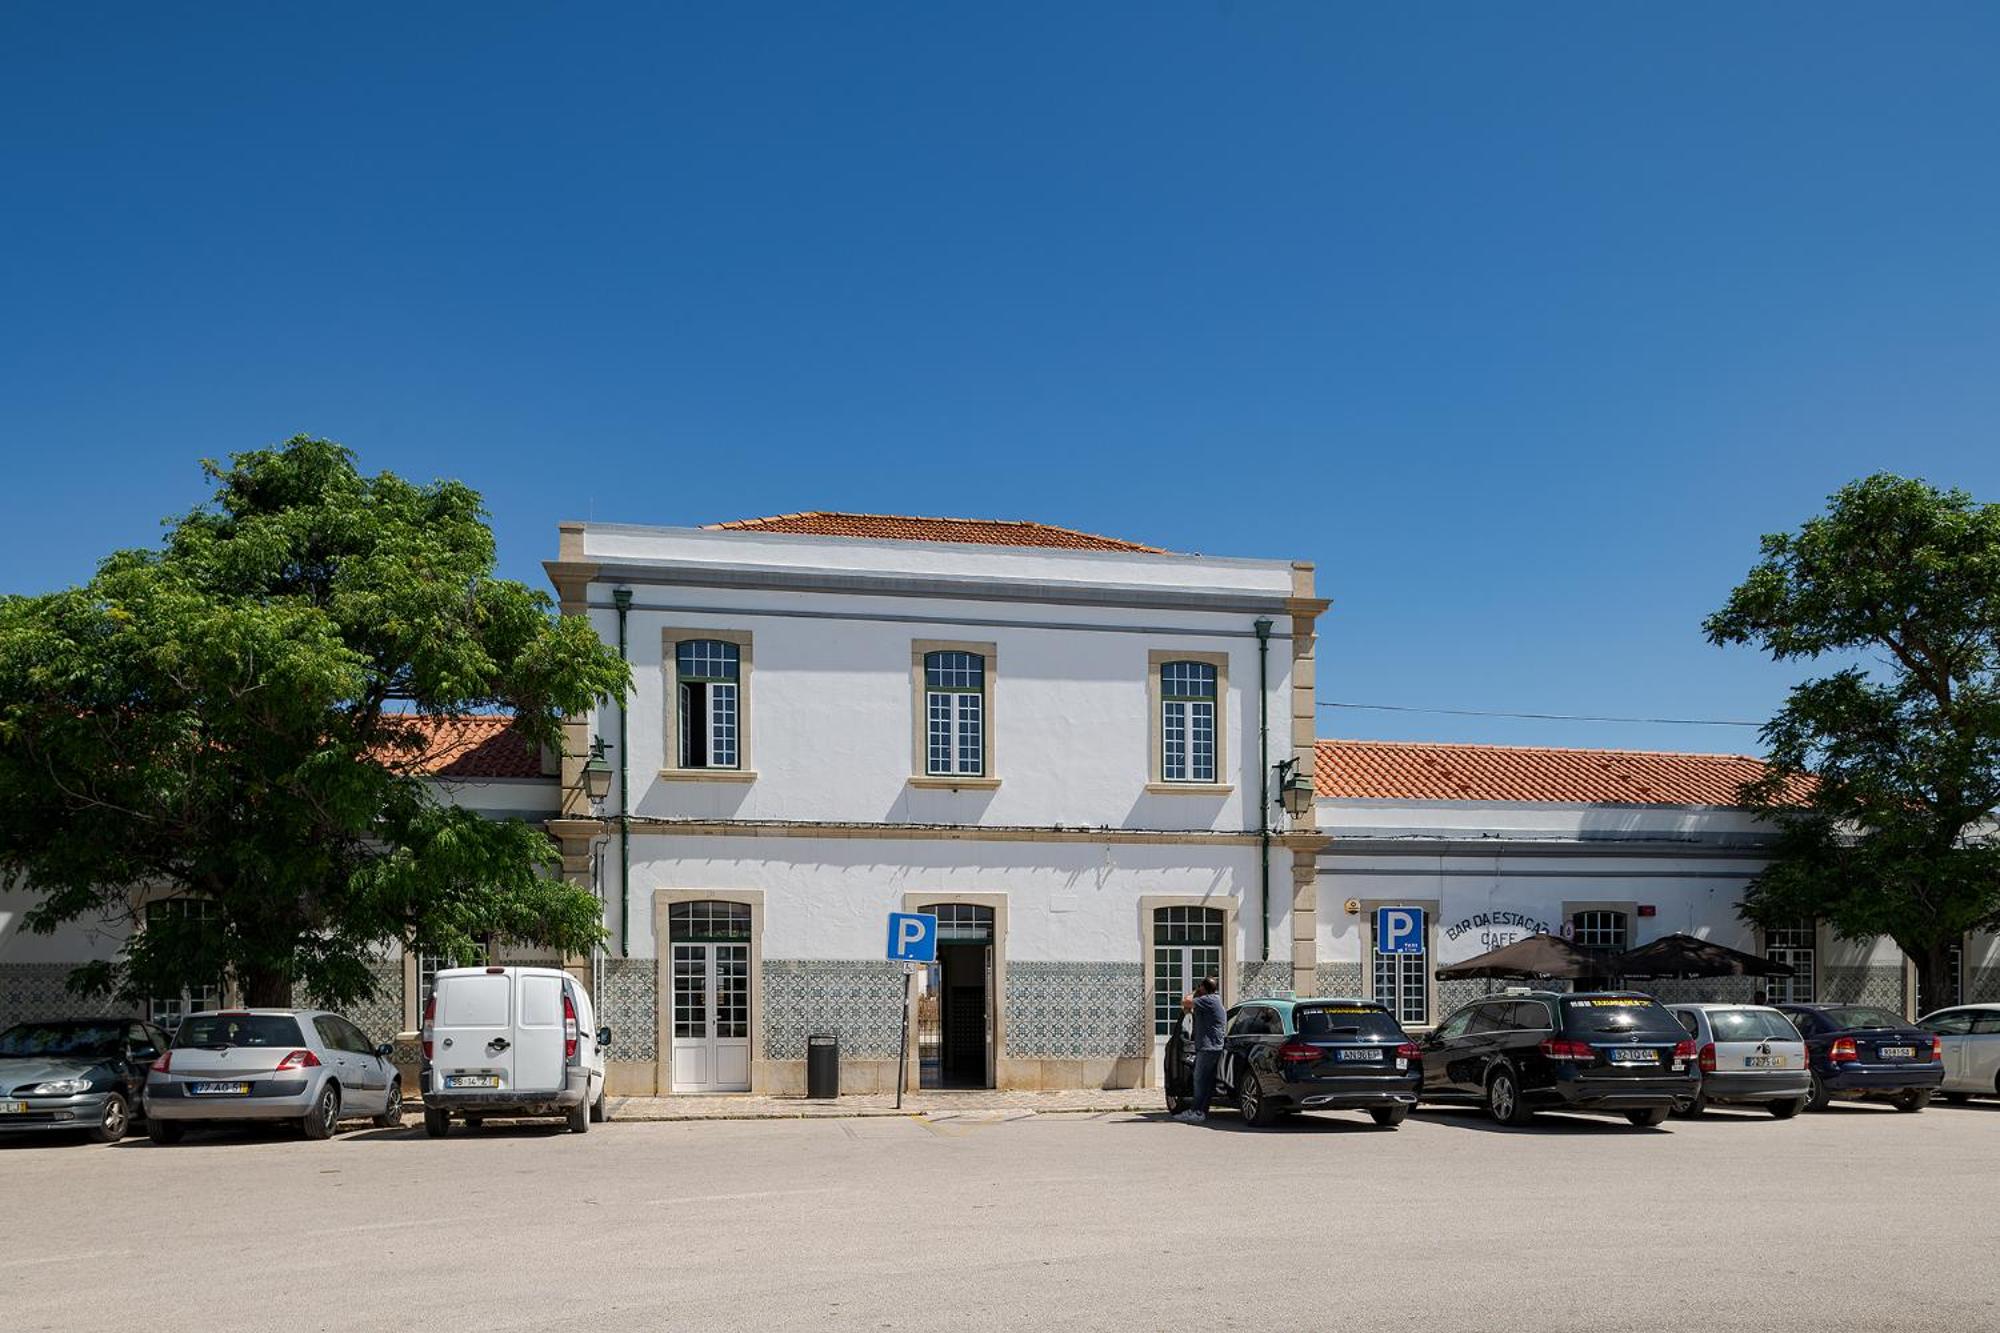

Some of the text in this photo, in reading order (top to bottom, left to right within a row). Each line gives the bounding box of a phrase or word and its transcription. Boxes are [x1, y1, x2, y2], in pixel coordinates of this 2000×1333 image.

[898, 918, 925, 955] P
[1388, 911, 1413, 949] P
[1446, 919, 1472, 941] BAR
[1472, 913, 1492, 928] DA
